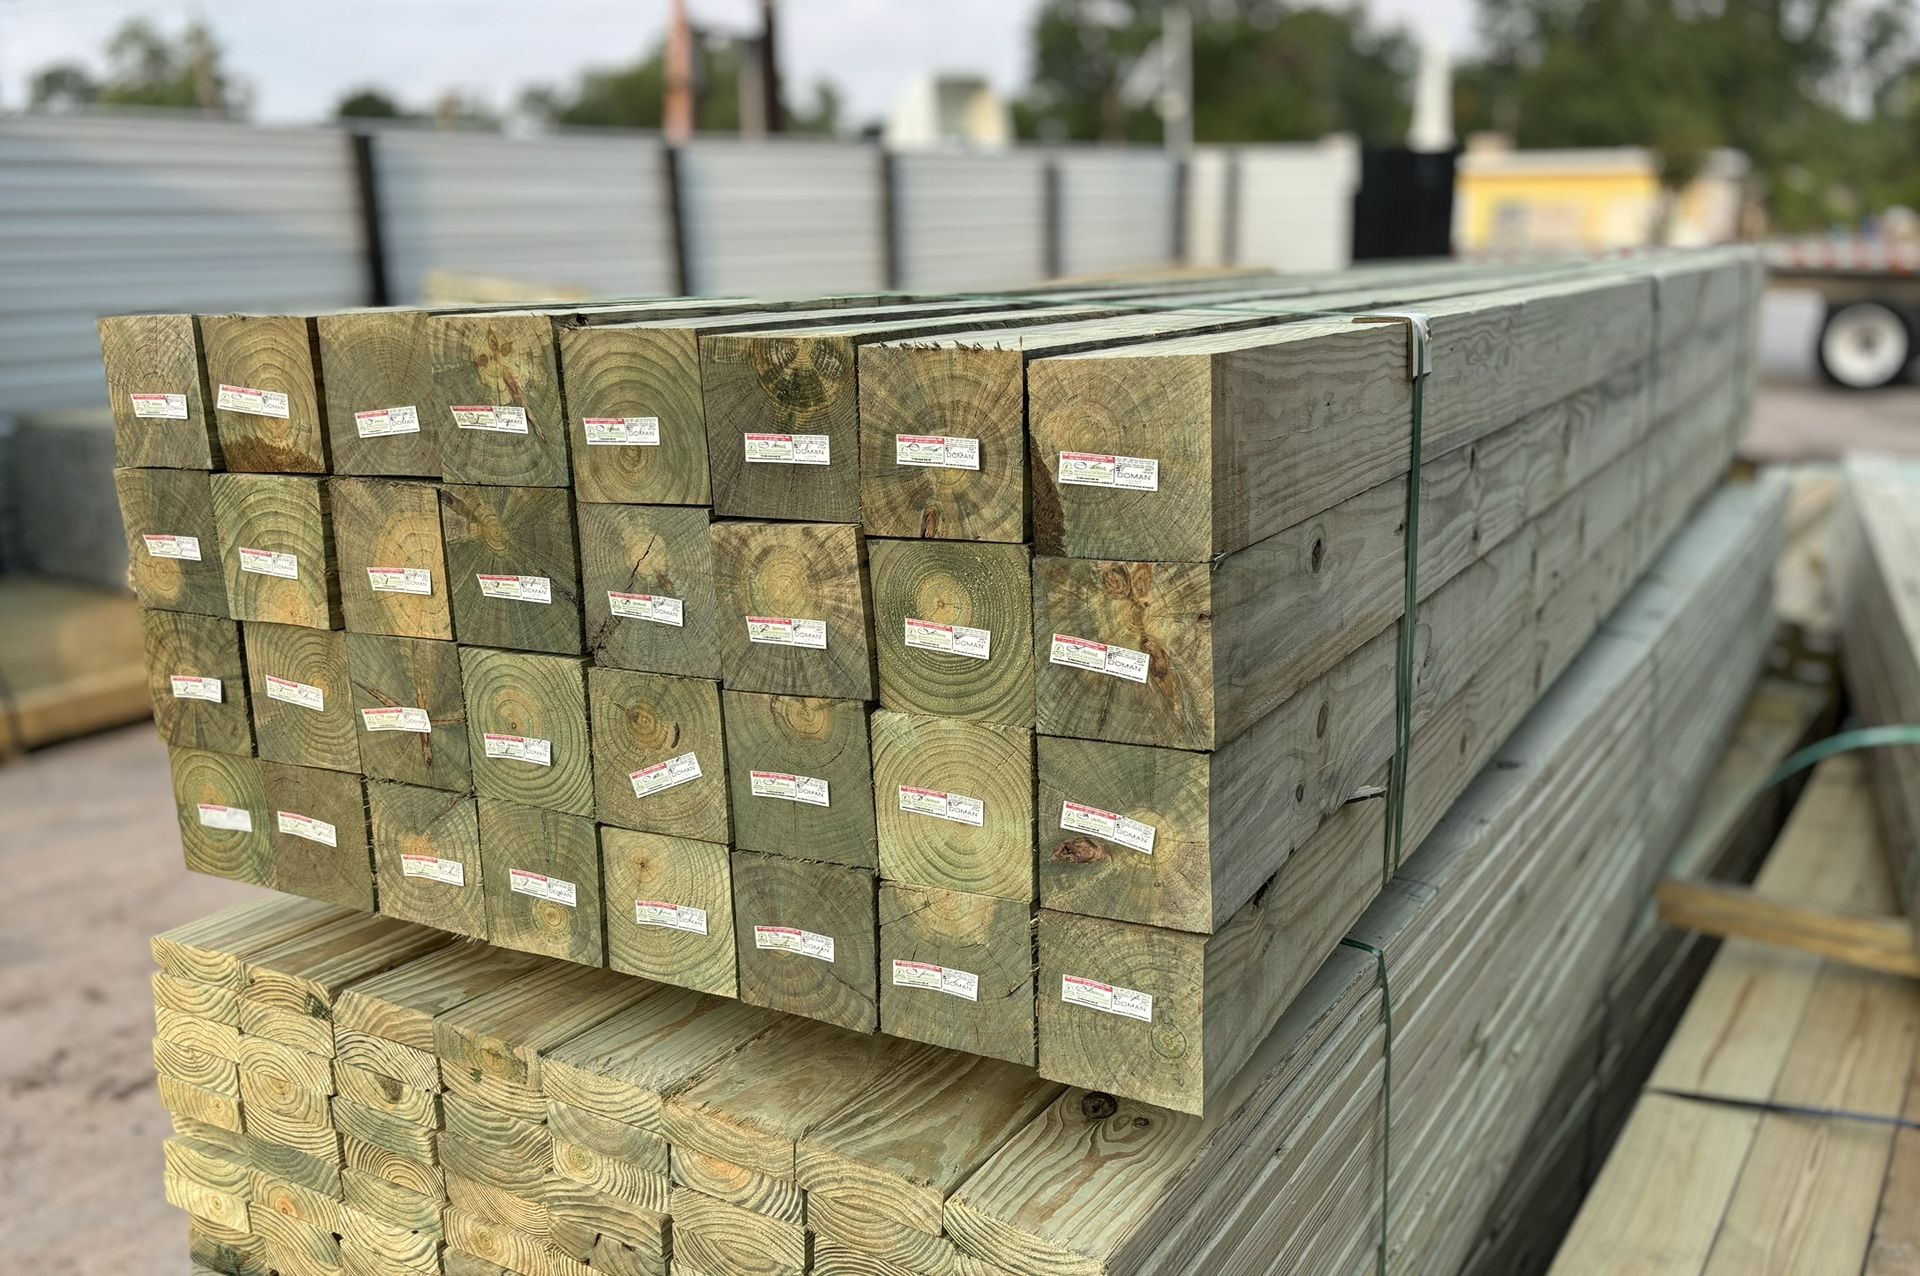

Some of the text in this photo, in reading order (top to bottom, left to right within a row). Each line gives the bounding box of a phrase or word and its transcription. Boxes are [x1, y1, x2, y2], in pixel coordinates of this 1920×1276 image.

[946, 452, 974, 460] DOMAN
[1117, 471, 1151, 481] DOMAN
[522, 587, 547, 595] DOMAN
[794, 632, 822, 640] DOMAN
[955, 640, 984, 649] DOMAN
[1108, 659, 1141, 672] DOMAN
[798, 788, 823, 797] DOMAN
[949, 807, 978, 817] DOMAN
[1116, 828, 1147, 843] DOMAN
[679, 917, 703, 926] DOMAN
[803, 943, 830, 953] DOMAN
[944, 981, 972, 992] DOMAN
[1114, 1000, 1146, 1012] DOMAN
